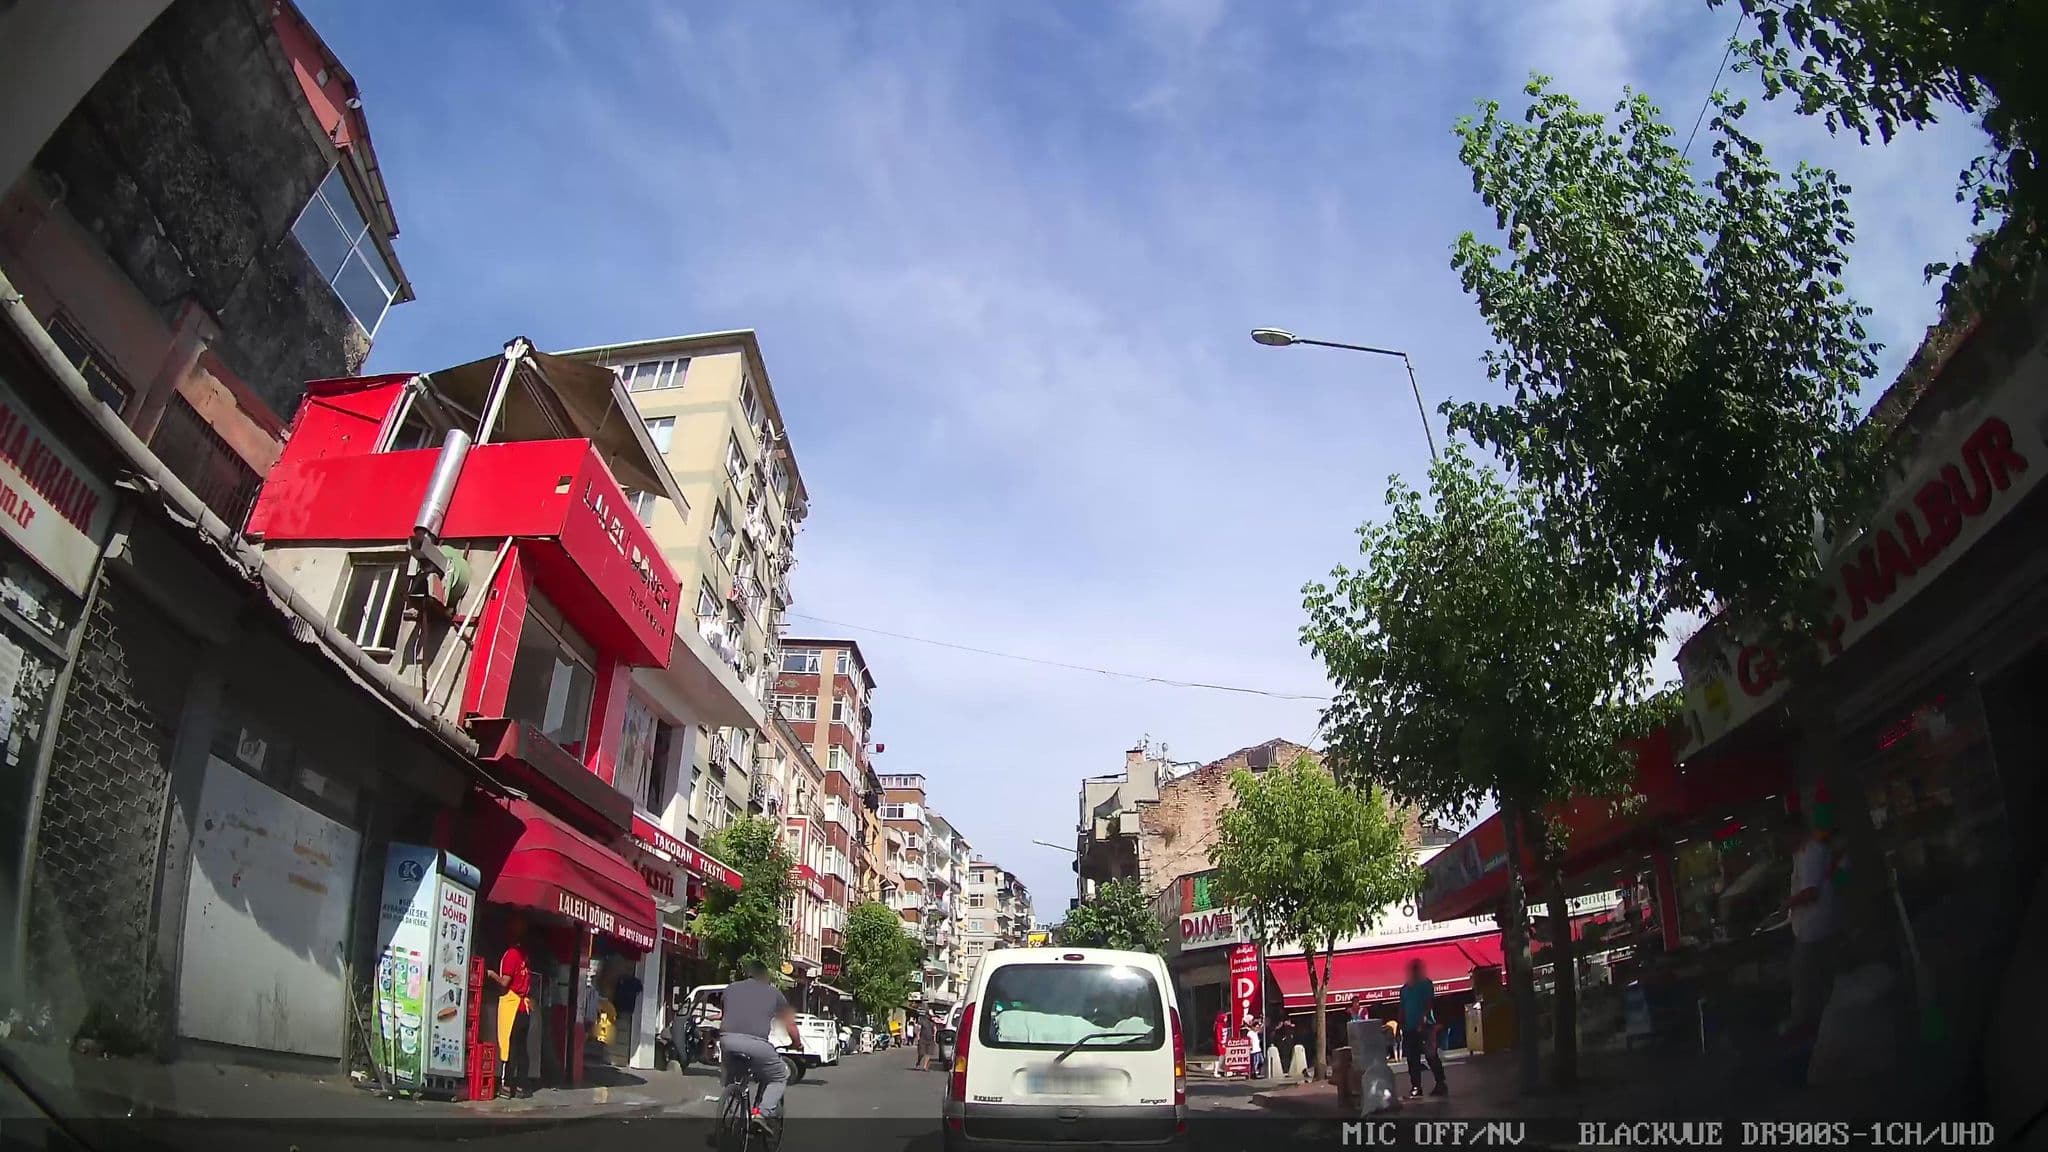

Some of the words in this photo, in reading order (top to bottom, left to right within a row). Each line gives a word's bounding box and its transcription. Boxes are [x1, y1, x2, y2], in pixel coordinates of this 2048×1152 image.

[1841, 418, 2028, 621] NALBUR
[654, 832, 693, 864] TAKORAN
[700, 858, 727, 882] TEKSTİL
[559, 893, 587, 921] LALELİ
[588, 907, 615, 933] DÖNER
